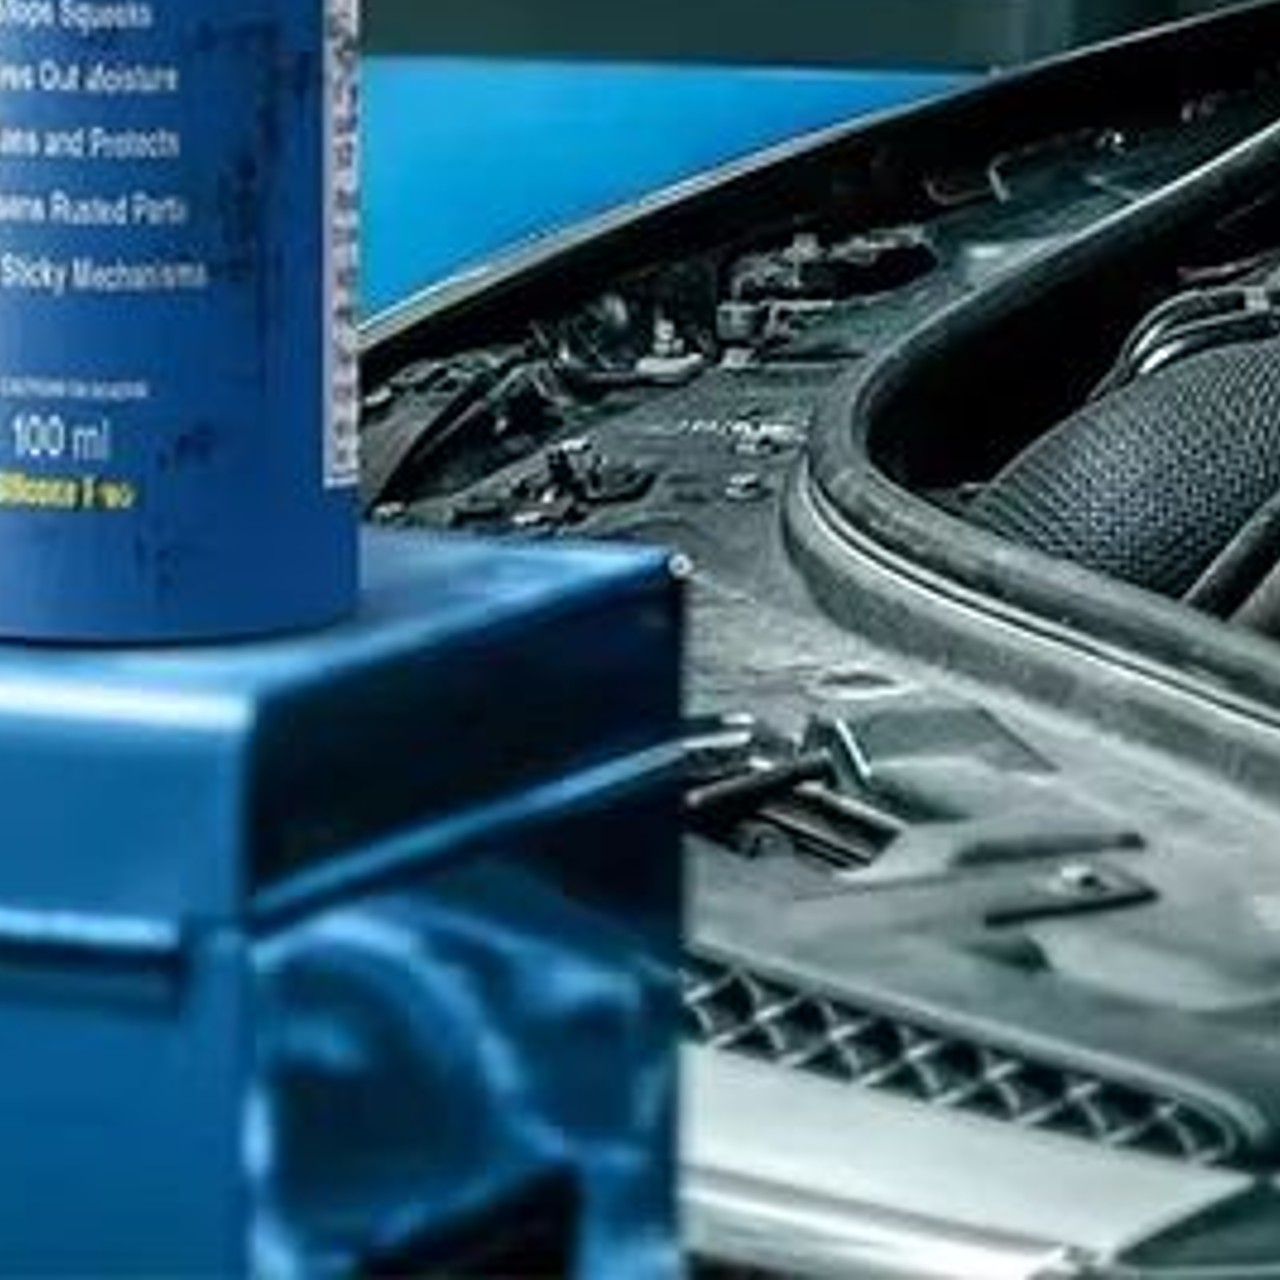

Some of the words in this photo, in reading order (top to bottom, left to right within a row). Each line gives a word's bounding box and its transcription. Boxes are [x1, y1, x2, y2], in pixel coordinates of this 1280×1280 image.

[39, 58, 80, 91] Out
[44, 126, 86, 157] and
[50, 189, 127, 225] Rusted
[0, 251, 66, 296] Sticky
[13, 413, 66, 458] 100
[72, 415, 110, 460] ml
